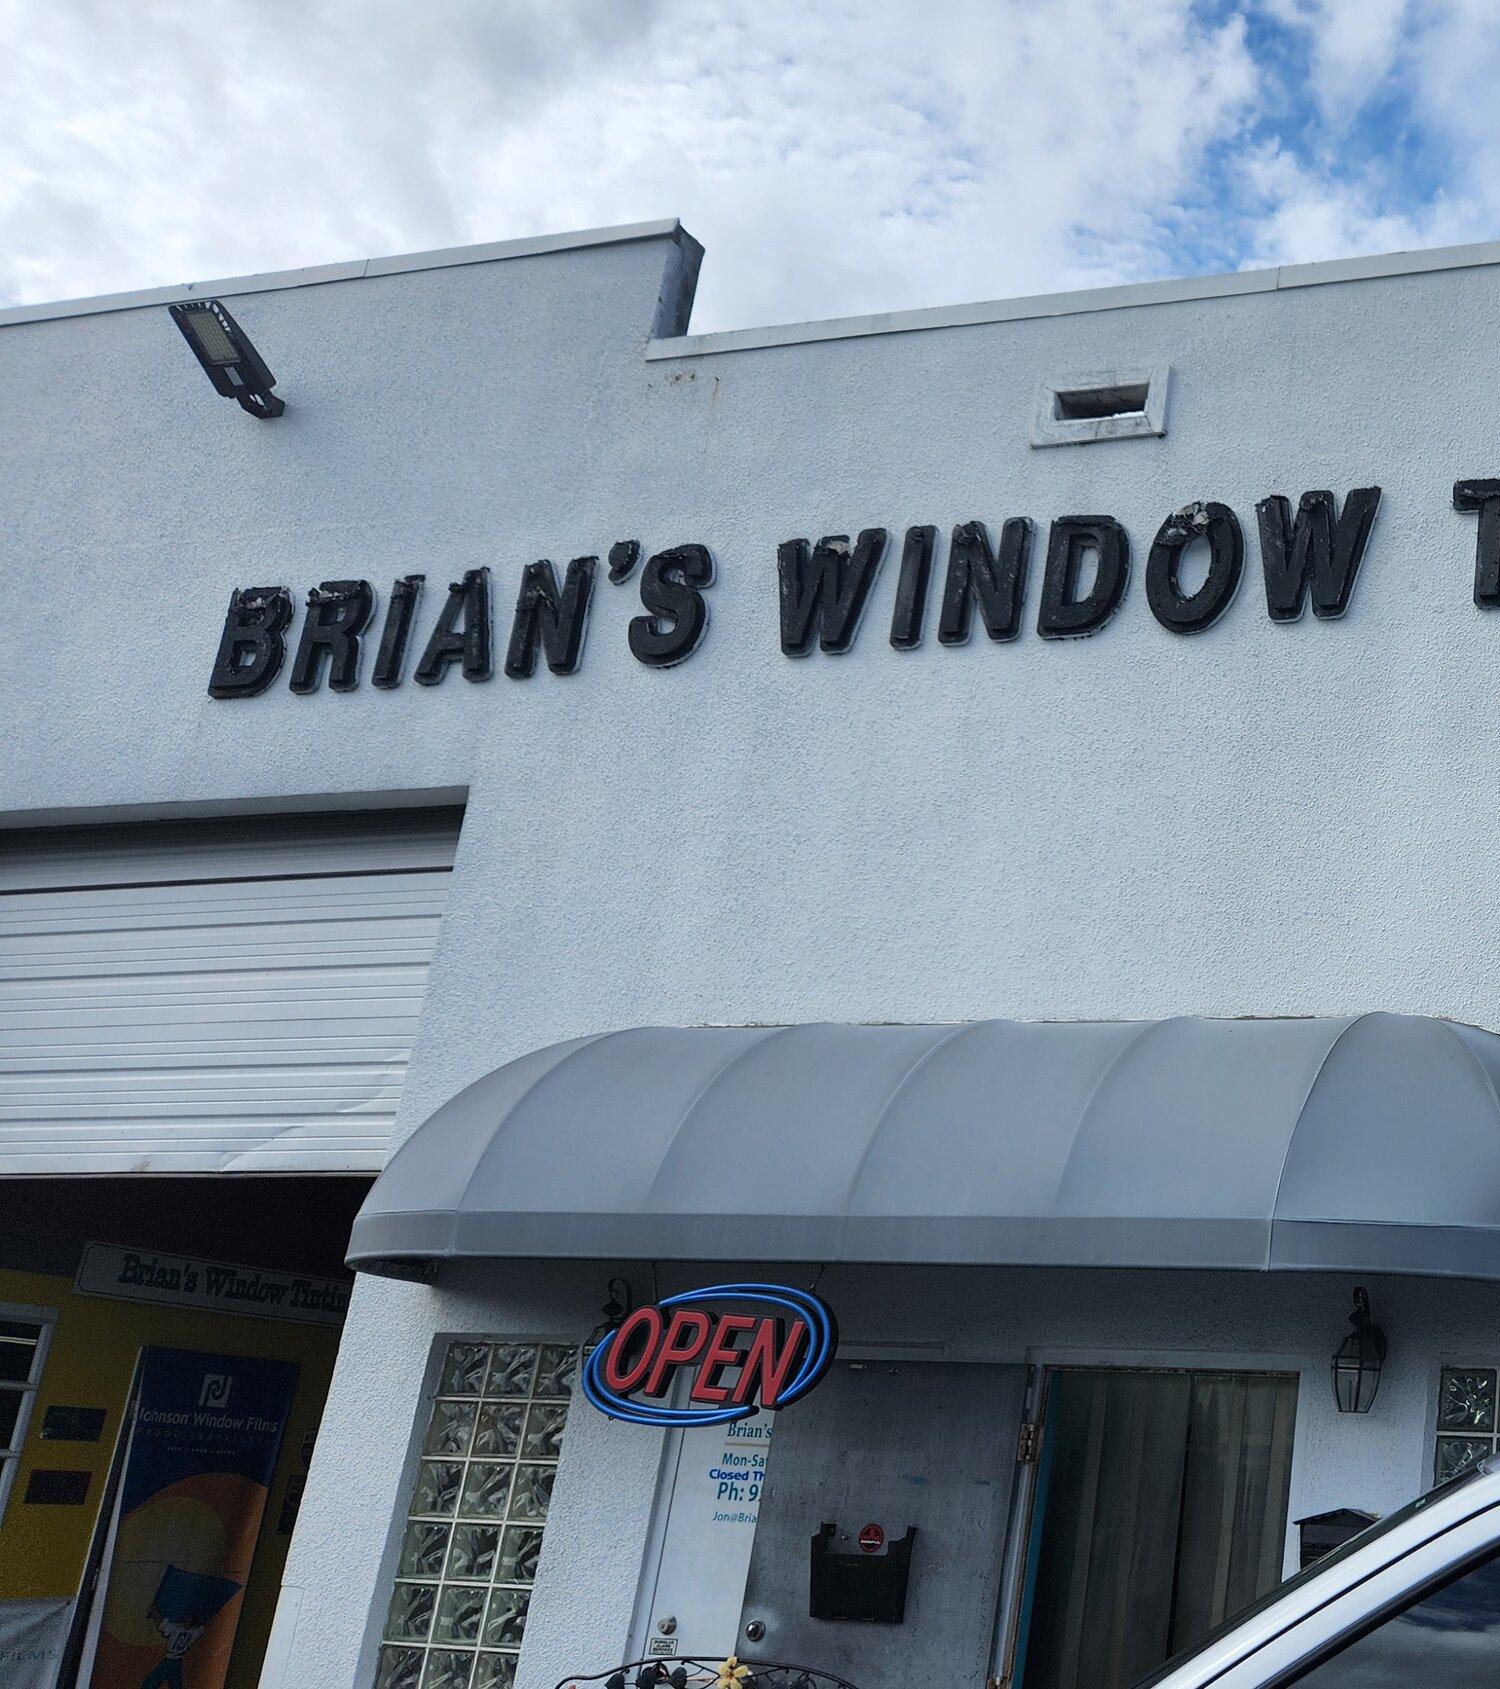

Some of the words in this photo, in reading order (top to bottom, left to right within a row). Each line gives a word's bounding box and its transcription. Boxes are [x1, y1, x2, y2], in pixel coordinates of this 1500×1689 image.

[208, 539, 717, 699] BRIAN'S
[777, 486, 1383, 658] WINDOW
[118, 1253, 199, 1293] Brian's
[205, 1265, 288, 1306] Window
[605, 1306, 807, 1407] OPEN
[137, 1407, 189, 1425] Johnson
[193, 1411, 244, 1429] Window
[245, 1417, 278, 1432] Films
[727, 1421, 773, 1438] Brian's
[709, 1468, 750, 1481] Closed
[717, 1481, 744, 1501] Ph:
[748, 1484, 761, 1502] 9
